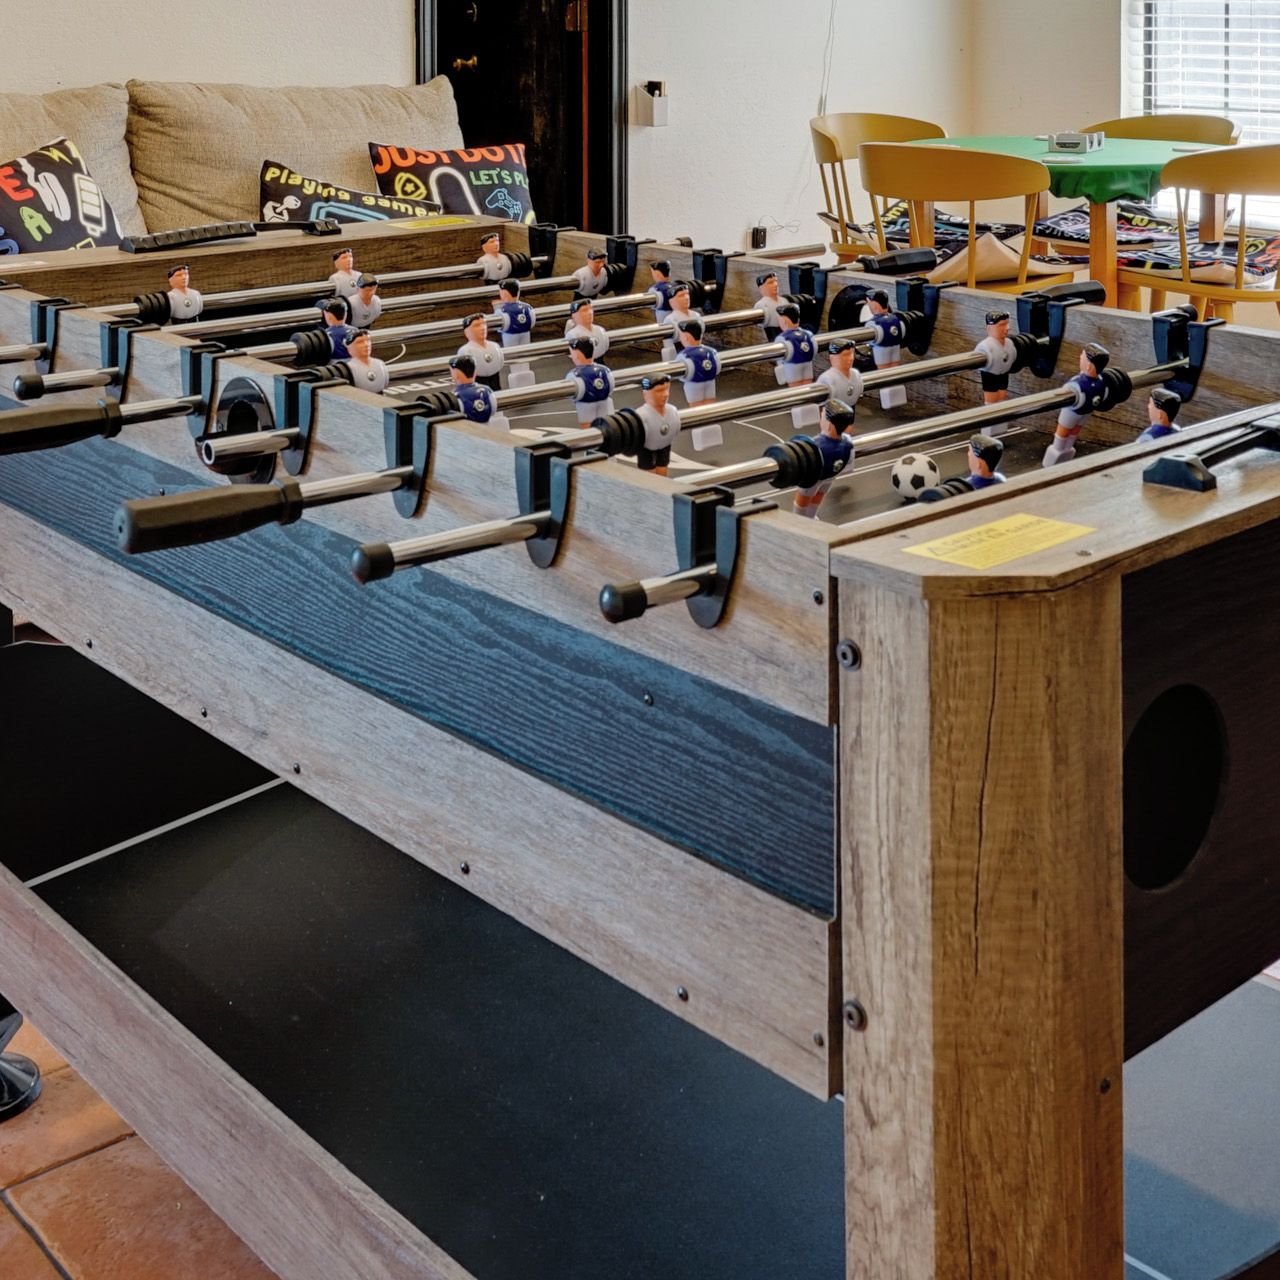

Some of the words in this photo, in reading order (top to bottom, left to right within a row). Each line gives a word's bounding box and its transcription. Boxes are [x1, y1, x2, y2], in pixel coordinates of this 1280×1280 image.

[264, 166, 351, 202] Playing
[469, 168, 513, 186] LET'S
[19, 206, 53, 242] A
